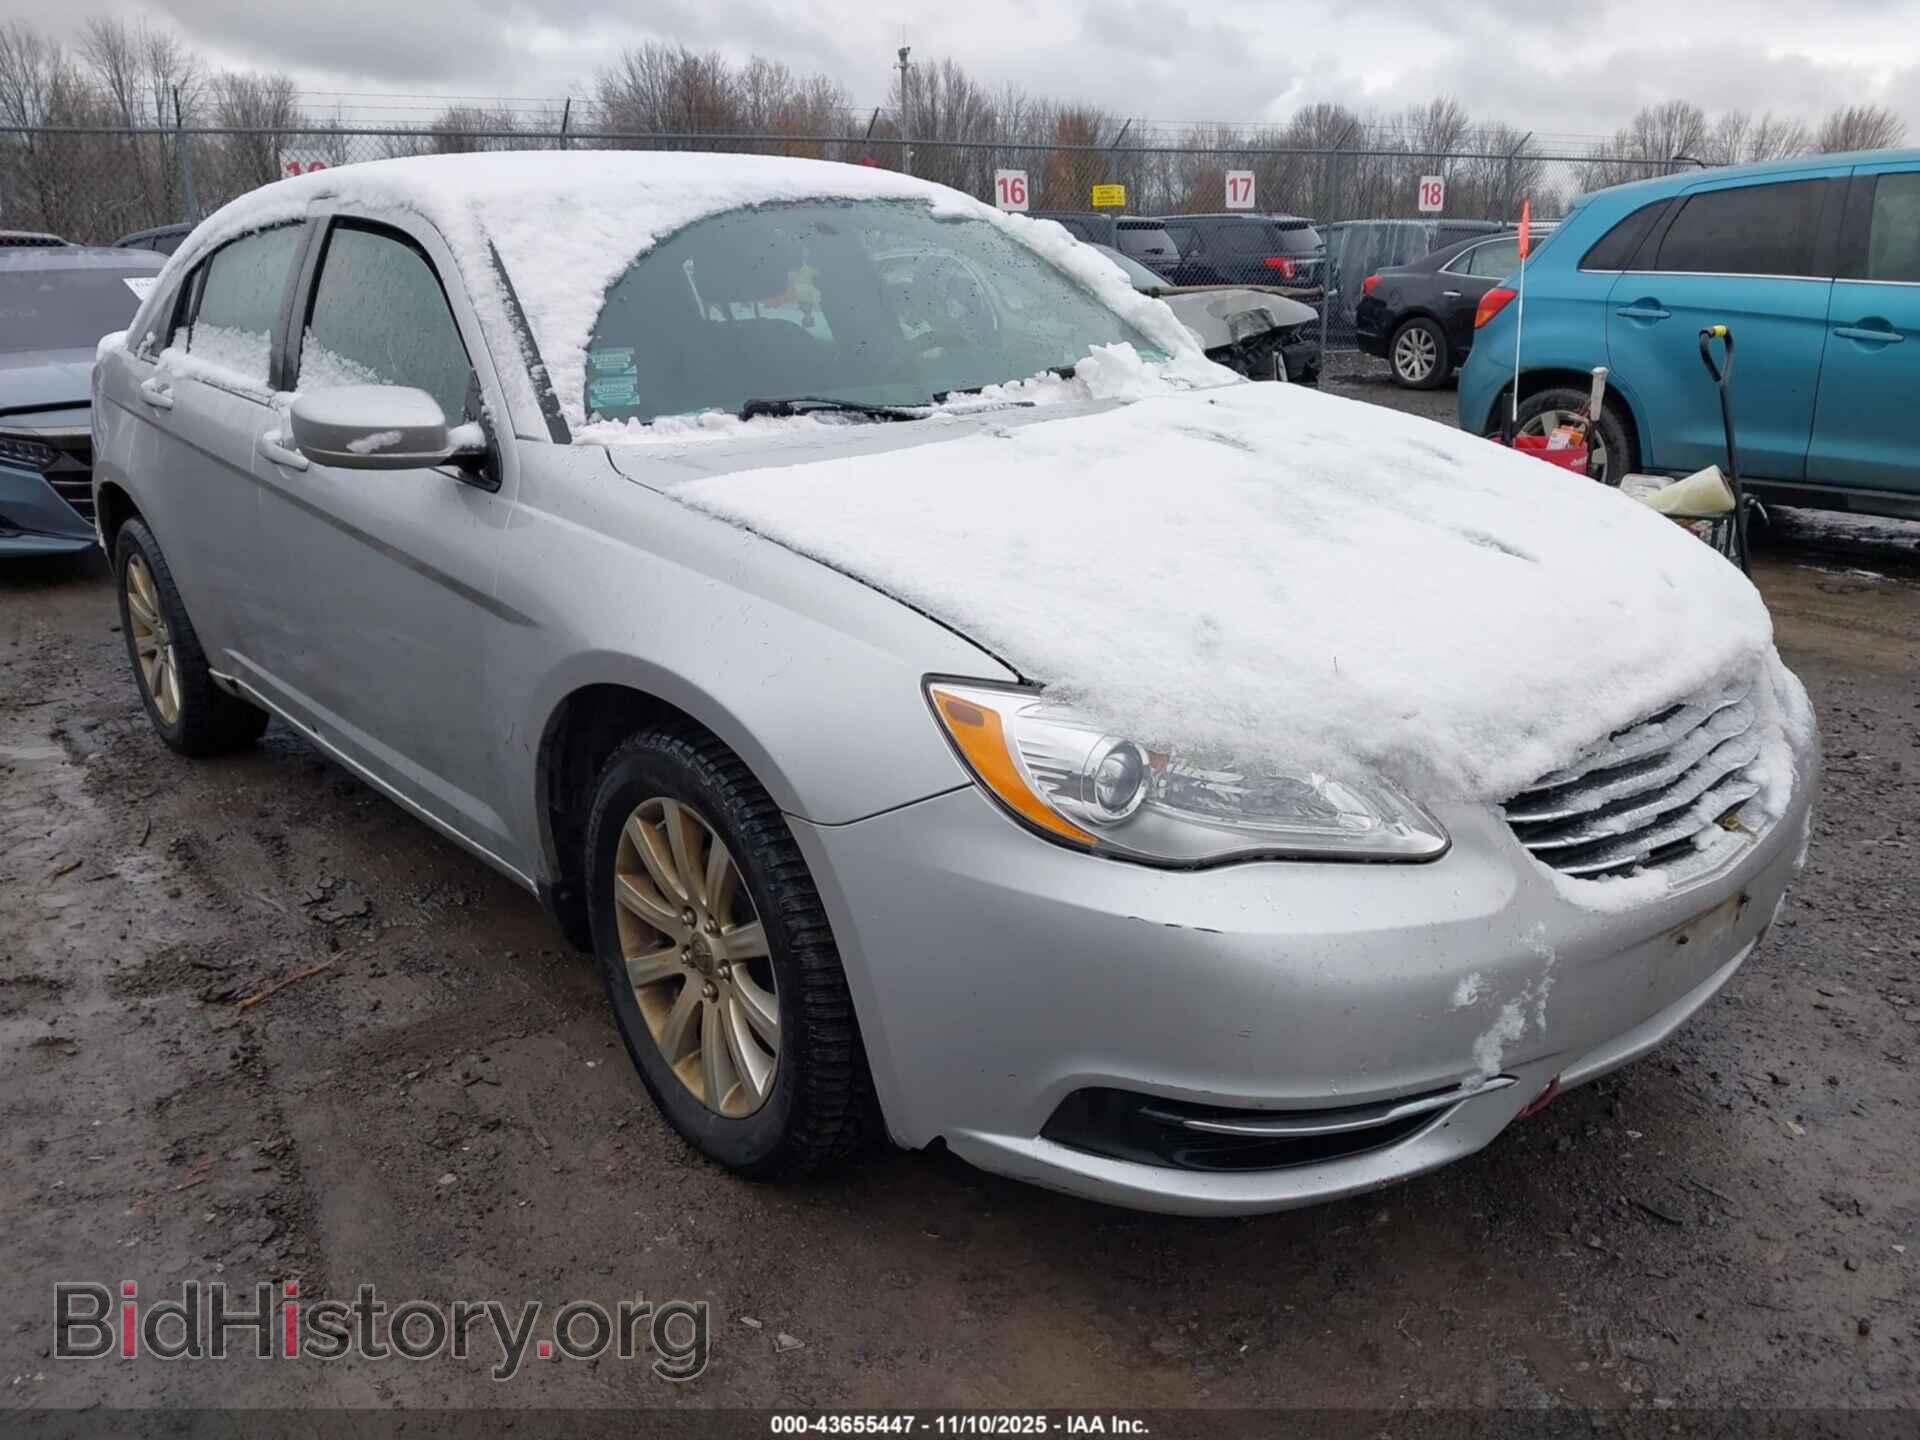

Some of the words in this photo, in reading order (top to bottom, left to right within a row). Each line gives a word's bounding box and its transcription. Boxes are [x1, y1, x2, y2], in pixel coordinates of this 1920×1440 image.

[997, 177, 1025, 204] 16
[1229, 177, 1252, 202] 17
[1422, 182, 1441, 205] 18
